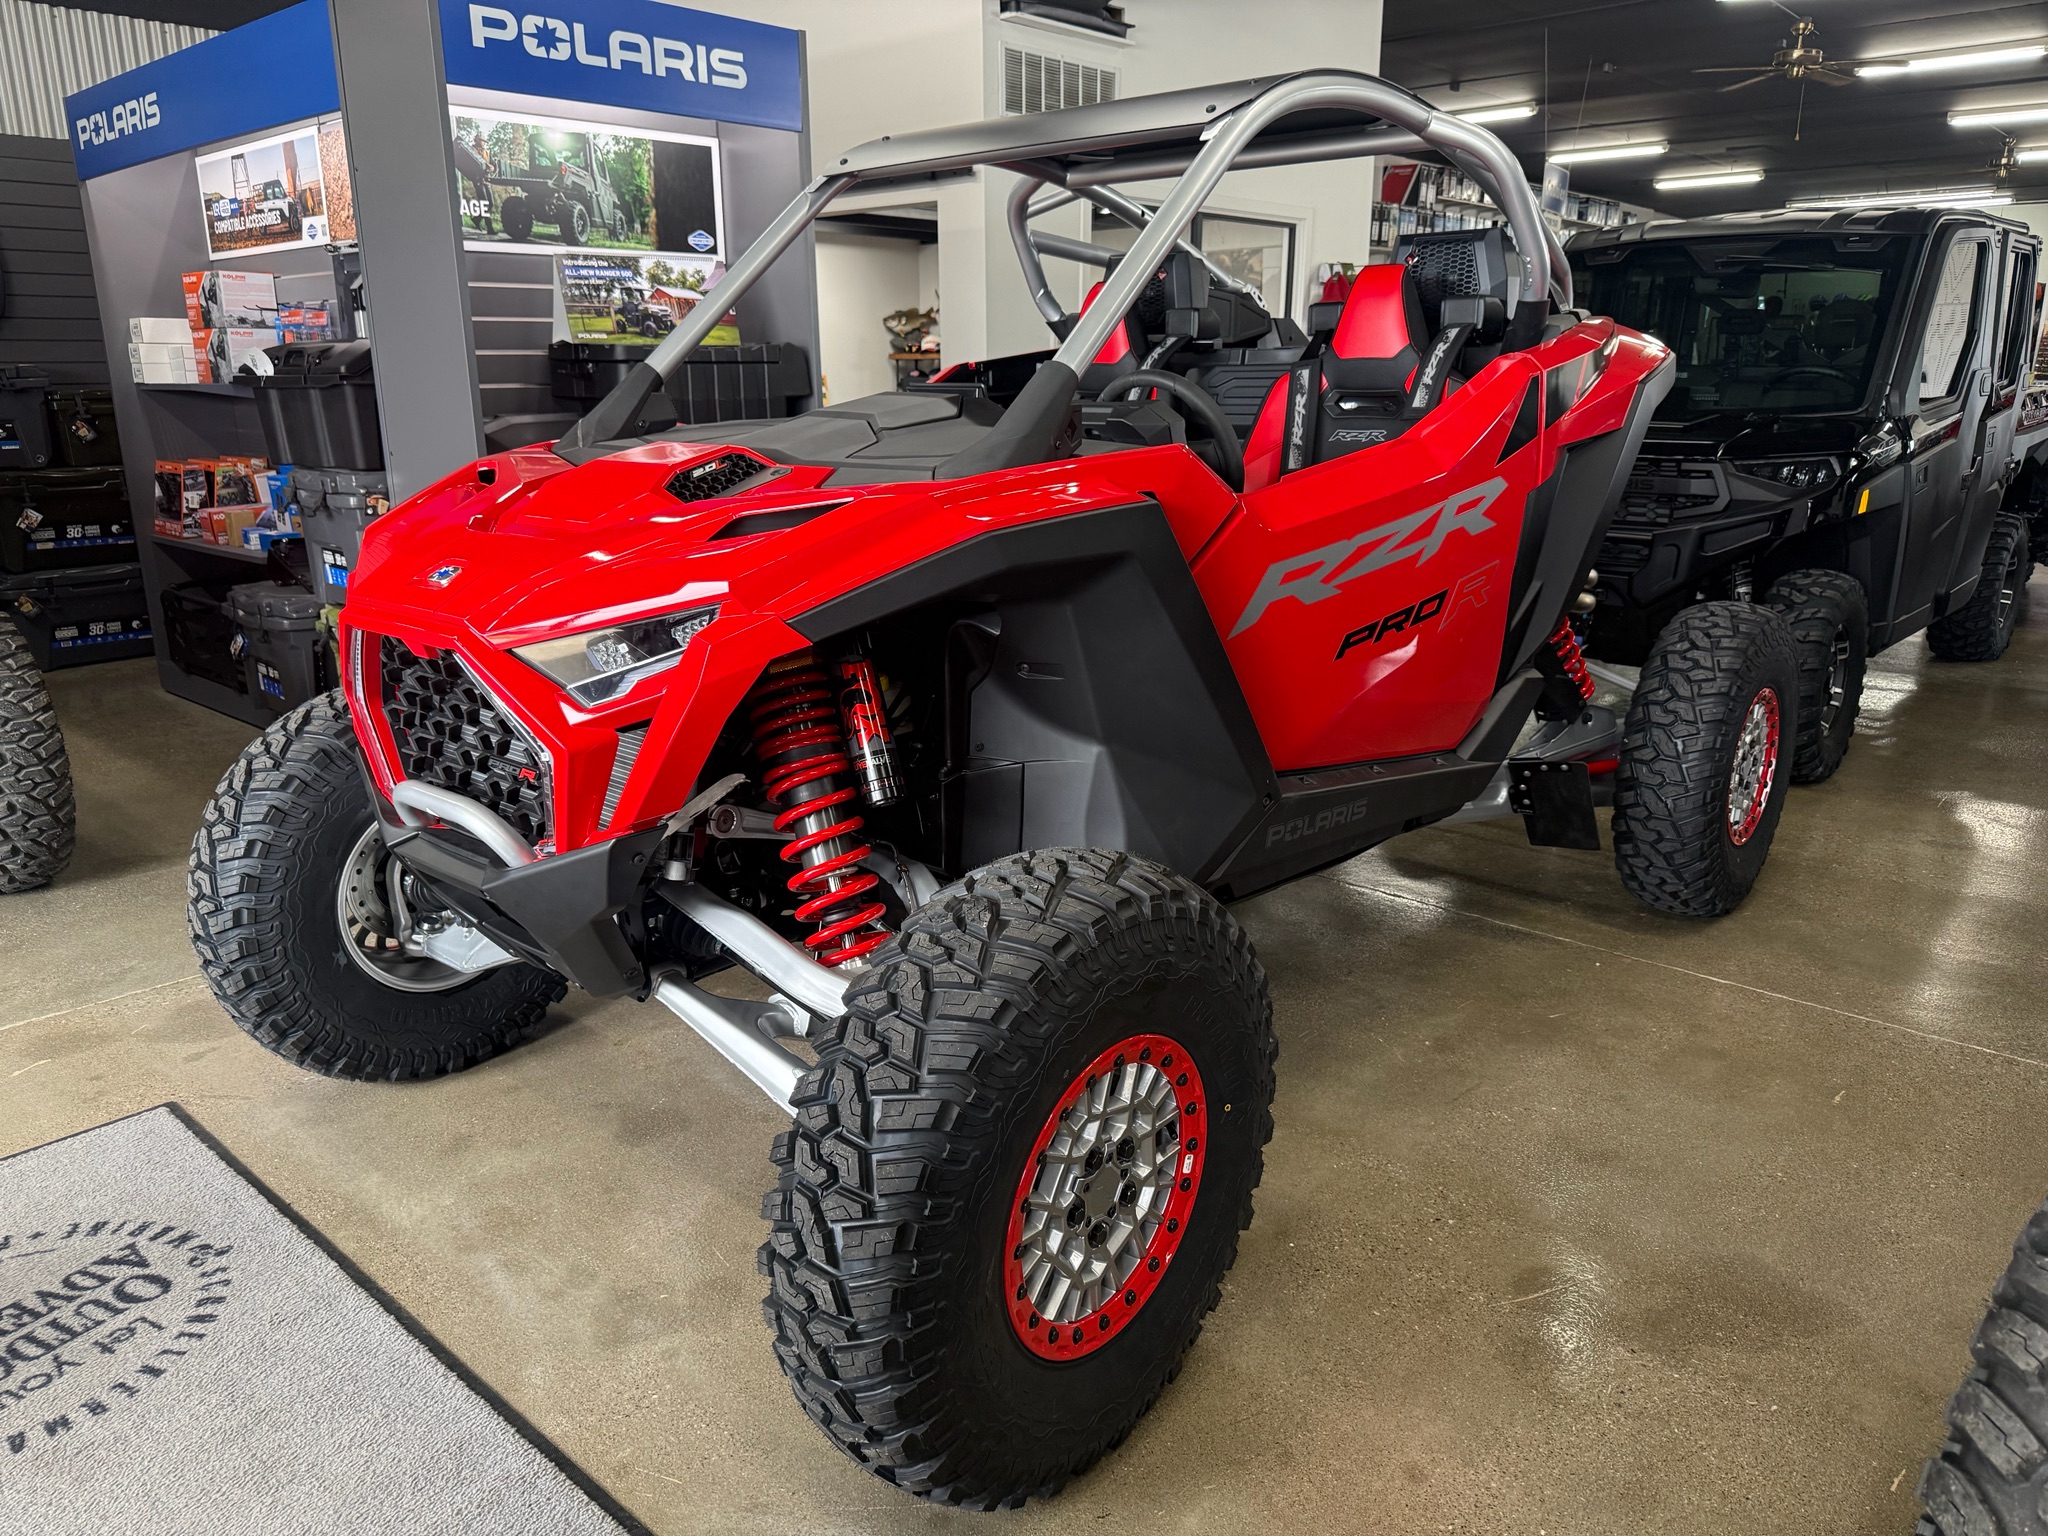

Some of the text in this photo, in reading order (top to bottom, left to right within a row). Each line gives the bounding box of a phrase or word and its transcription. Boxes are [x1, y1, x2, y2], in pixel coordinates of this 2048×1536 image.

[469, 3, 749, 90] POLARIS
[76, 91, 161, 150] POLARIS
[214, 210, 281, 234] COMPATIBLE ACCESSORIES
[562, 259, 597, 268] Introducing
[565, 268, 595, 276] ALL-NEW
[595, 269, 621, 277] RANGER
[1422, 340, 1450, 385] RZR
[1292, 391, 1308, 446] RZR
[1328, 429, 1387, 442] RZR
[1228, 476, 1508, 640] RZR
[1334, 559, 1500, 660] PRO R
[841, 658, 892, 749] FOX
[489, 760, 537, 783] PRO R
[1266, 797, 1368, 850] POLARIS
[93, 1316, 165, 1355] Let
